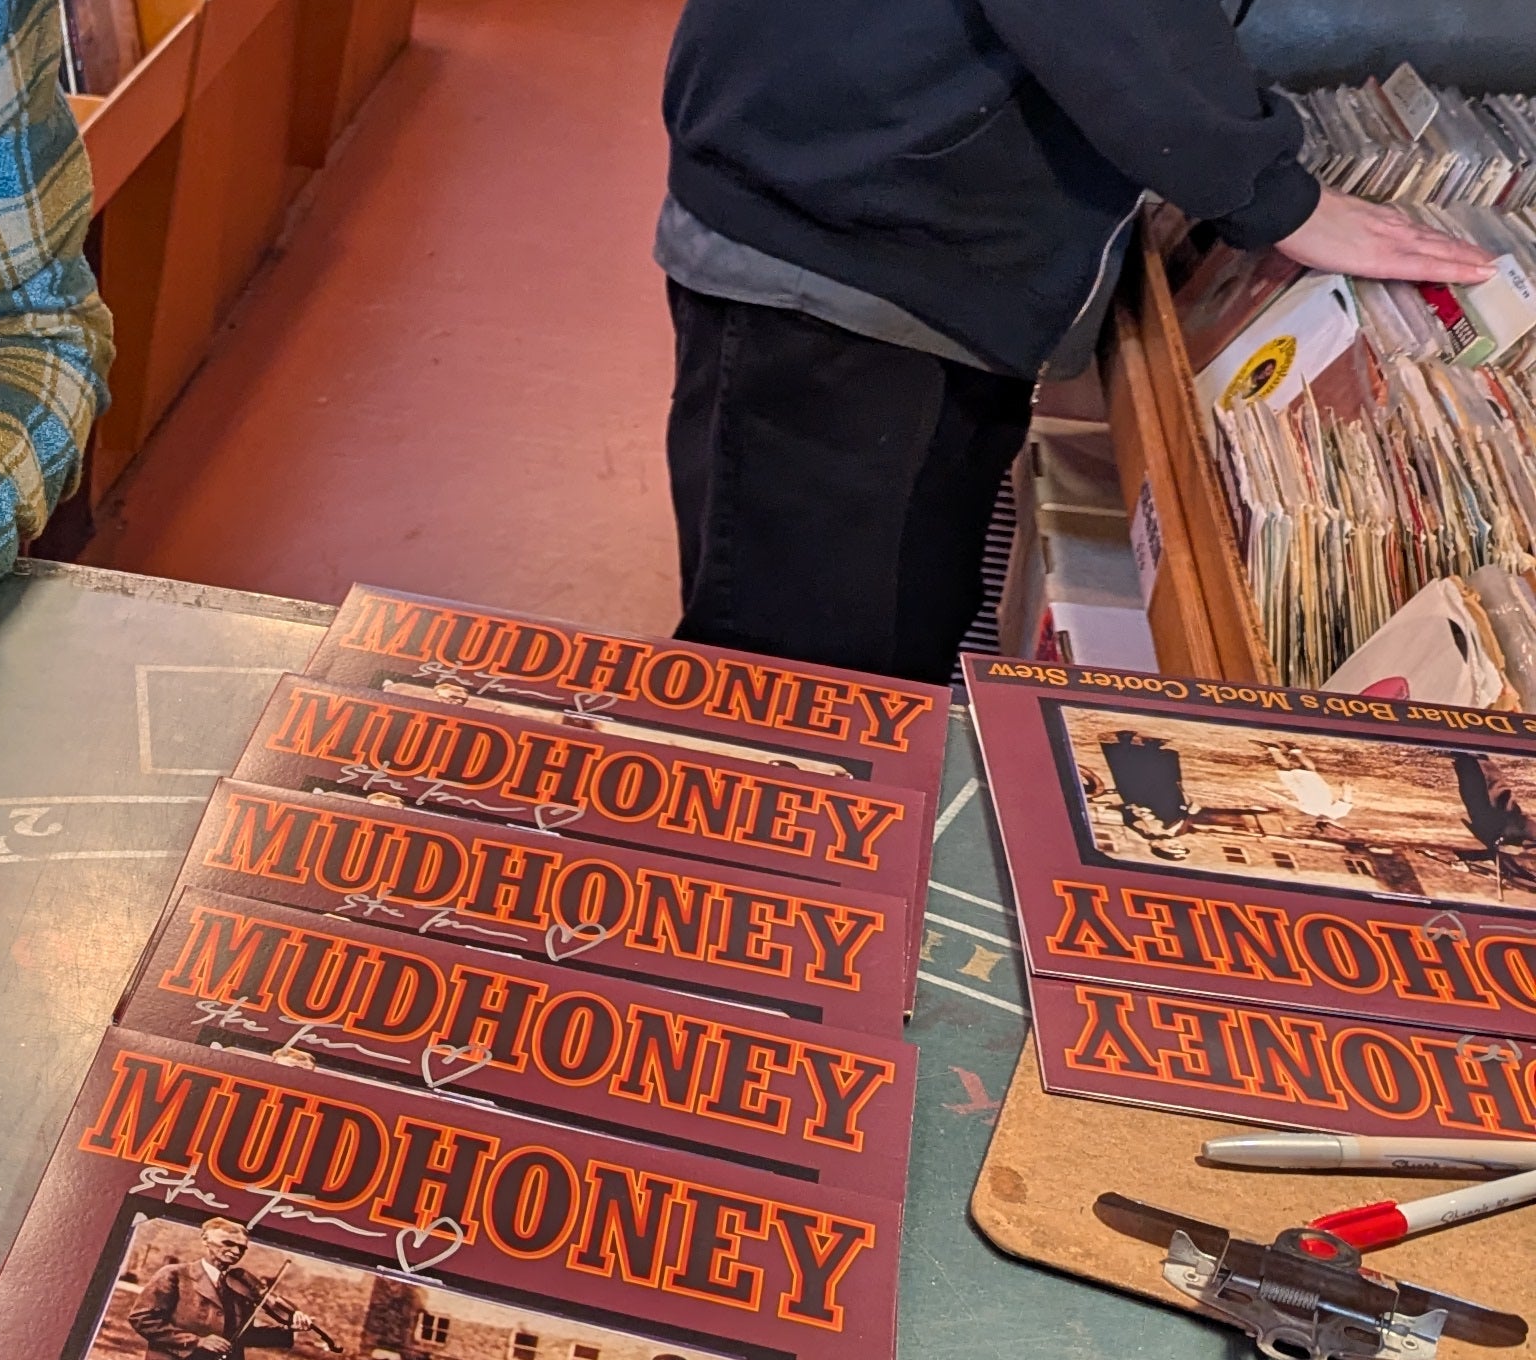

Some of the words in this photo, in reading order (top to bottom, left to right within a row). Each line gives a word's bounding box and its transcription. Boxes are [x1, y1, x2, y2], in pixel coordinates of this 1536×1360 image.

[339, 594, 934, 753] MUDHONEY
[989, 661, 1070, 687] Stew
[1077, 670, 1190, 702] Cooter
[1199, 681, 1293, 712] Mock
[1303, 693, 1399, 723] Bob's
[1406, 701, 1510, 735] Dollar
[266, 685, 906, 871] MUDHONEY
[204, 792, 887, 992] MUDHONEY
[1046, 880, 1536, 1018] DHONEY
[158, 905, 897, 1153] MUDHONEY
[1064, 985, 1536, 1138] HONEY
[78, 1050, 876, 1334] MUDHONEY
